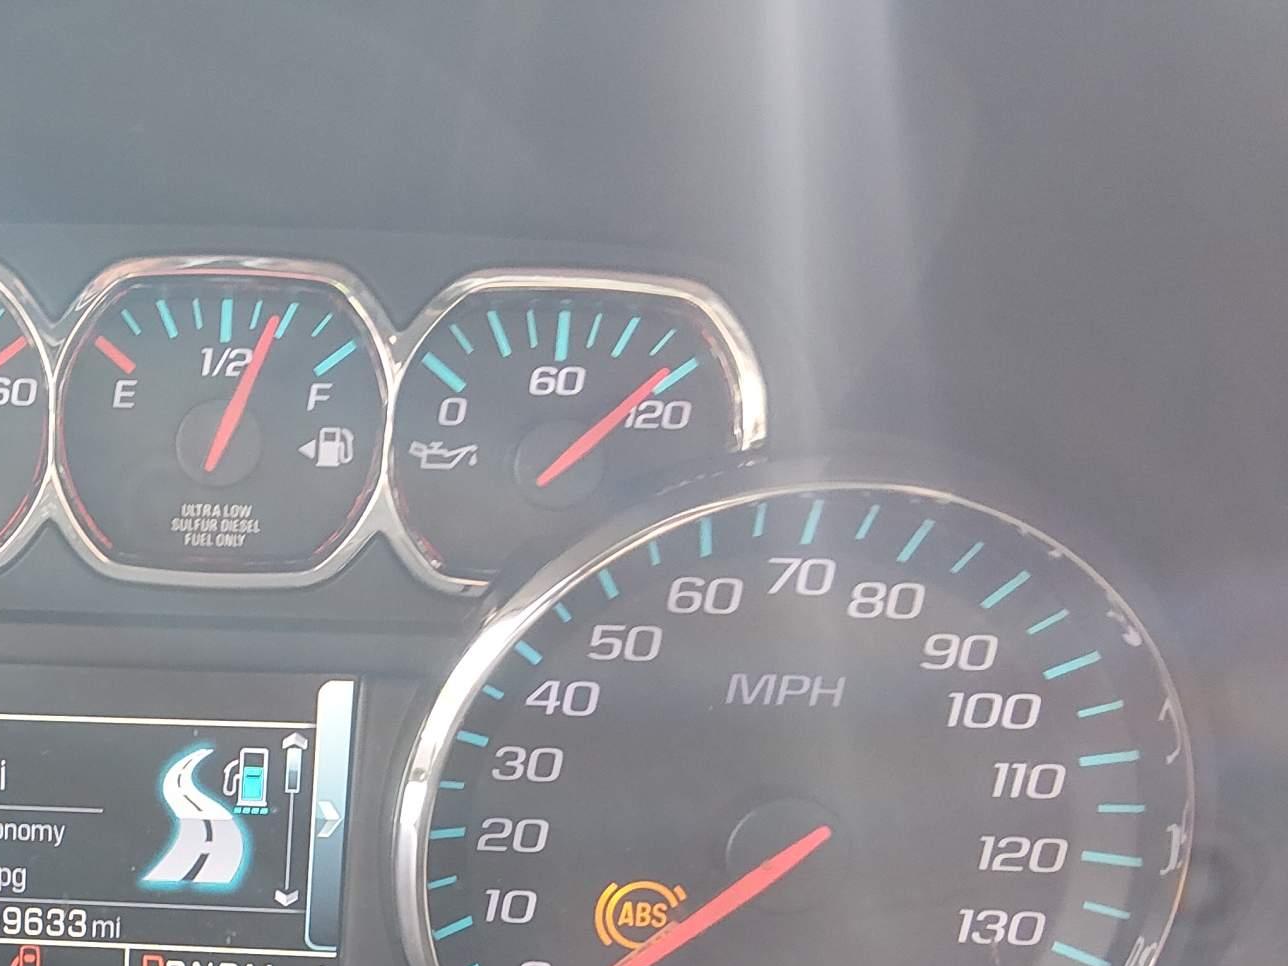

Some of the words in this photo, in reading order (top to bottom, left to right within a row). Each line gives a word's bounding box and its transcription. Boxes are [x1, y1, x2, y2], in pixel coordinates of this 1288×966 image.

[200, 346, 254, 377] 1/2
[113, 379, 138, 408] E
[307, 383, 333, 411] F
[529, 366, 586, 396] 60
[438, 397, 468, 426] 0
[171, 518, 219, 533] SULFUR
[220, 519, 261, 534] DIESEL
[181, 503, 222, 518] ULTRA
[223, 504, 253, 518] LOW
[184, 532, 214, 546] FUEL
[215, 533, 246, 547] ONLY
[768, 557, 836, 596] 70
[667, 576, 744, 615] 60
[847, 582, 925, 619] 80
[588, 624, 663, 662] 50
[921, 633, 999, 671] 90
[525, 680, 600, 717] 40
[726, 673, 846, 707] MPH
[947, 692, 1042, 730] 100
[491, 746, 564, 782] 30
[992, 762, 1066, 799] 110
[477, 817, 550, 853] 20
[978, 836, 1069, 873] 120
[486, 889, 537, 924] 10
[617, 901, 669, 928] ABS
[92, 918, 120, 939] mi
[958, 908, 1045, 946] 130
